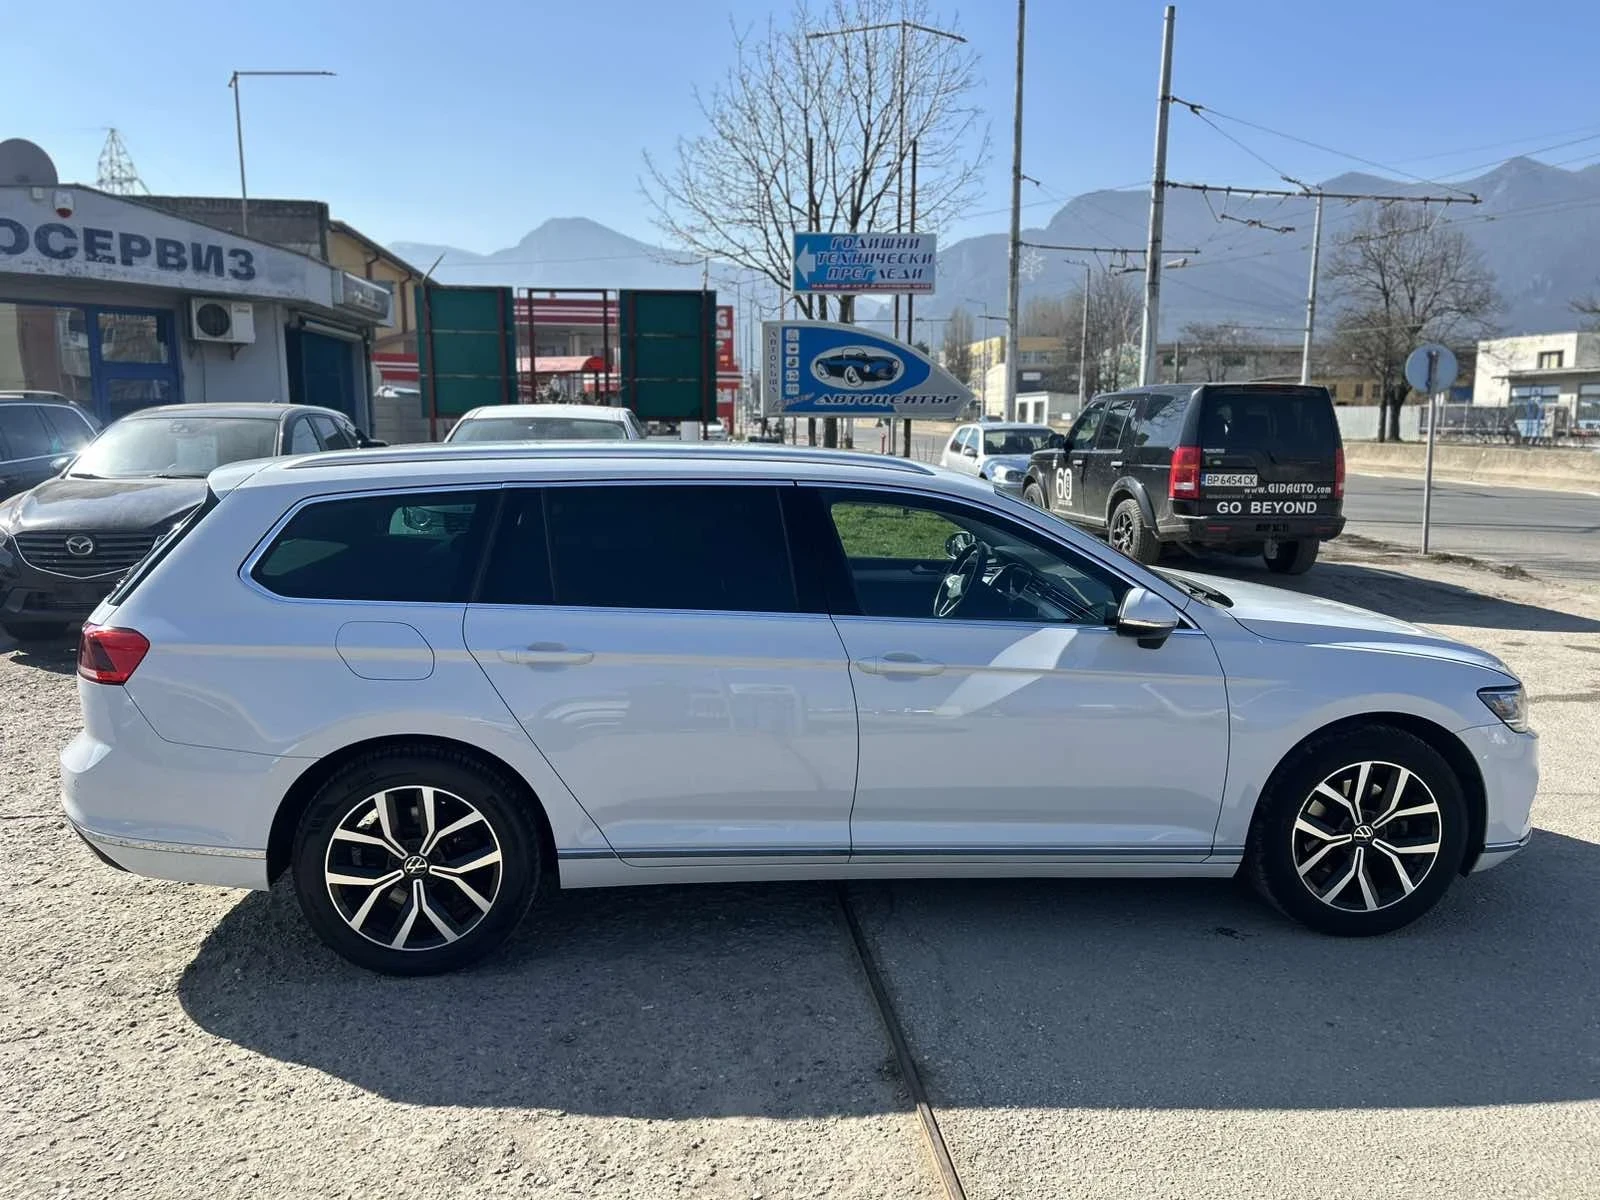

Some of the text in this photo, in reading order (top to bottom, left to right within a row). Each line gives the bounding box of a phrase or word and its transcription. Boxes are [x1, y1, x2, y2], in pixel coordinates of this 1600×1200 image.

[831, 235, 921, 250] ГОДИШНИ
[817, 251, 934, 266] ТЕХНИЧЕСКИ
[814, 393, 960, 407] АВТОЦЕНТЪР
[1216, 501, 1318, 514] GO BEYOND
